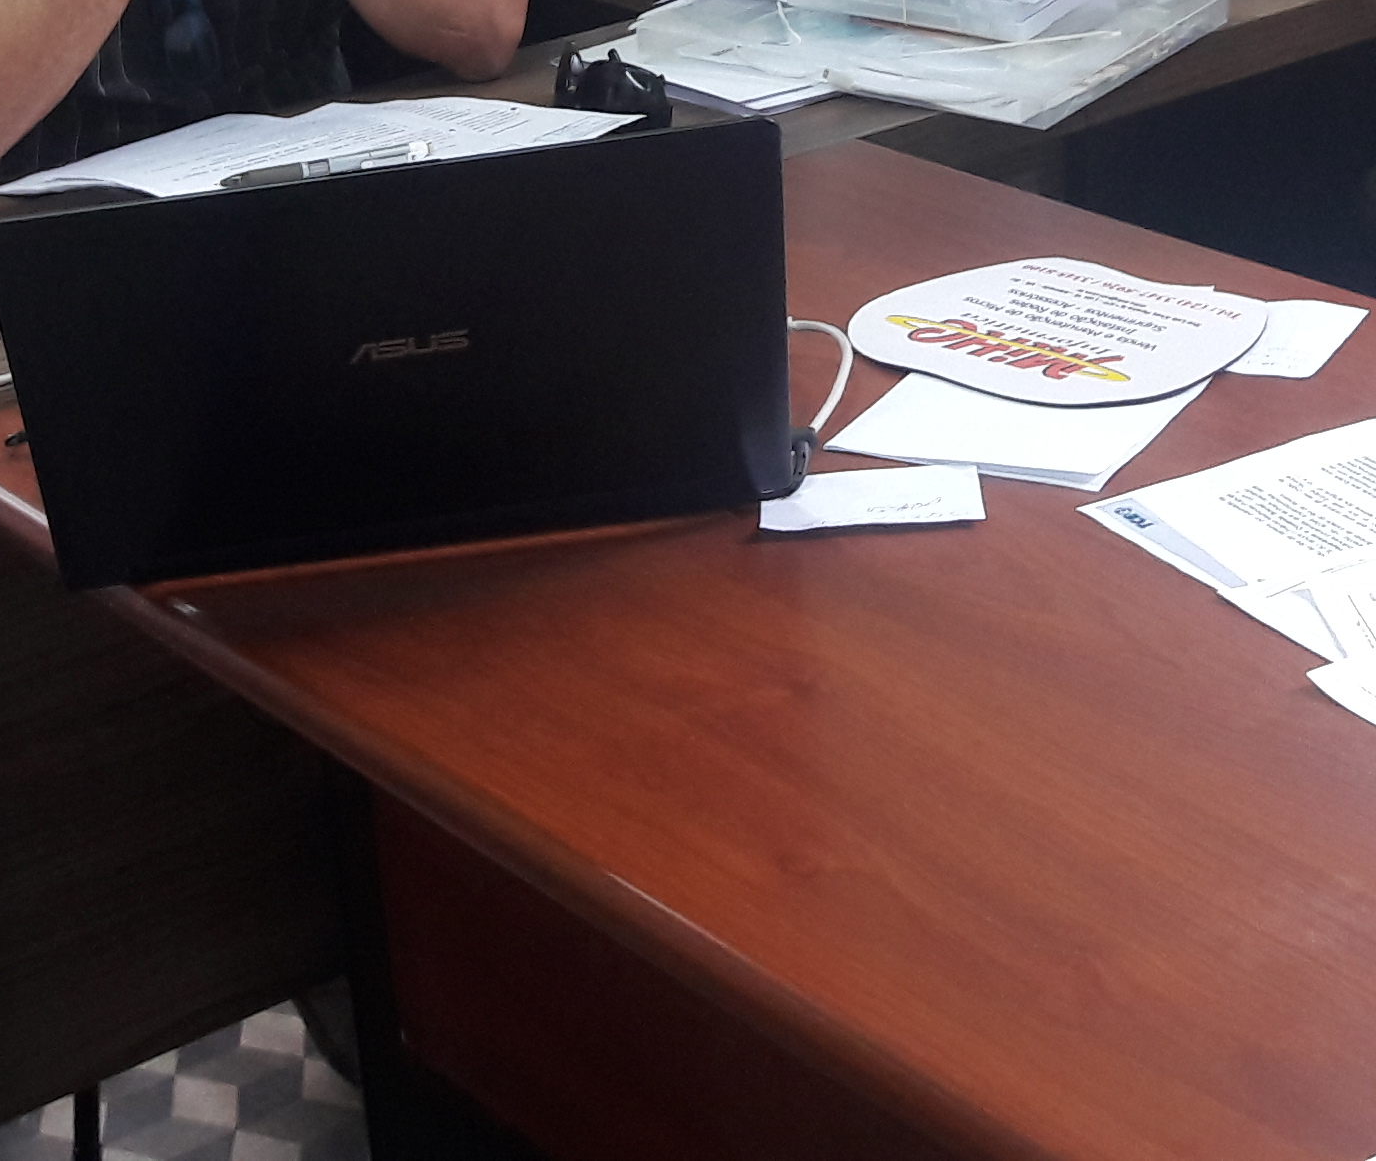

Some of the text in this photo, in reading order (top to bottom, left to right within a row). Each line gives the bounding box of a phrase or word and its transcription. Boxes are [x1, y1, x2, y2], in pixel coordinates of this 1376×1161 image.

[1024, 313, 1103, 338] Manutenção
[350, 329, 469, 364] ASUS
[1115, 336, 1158, 351] Venda
